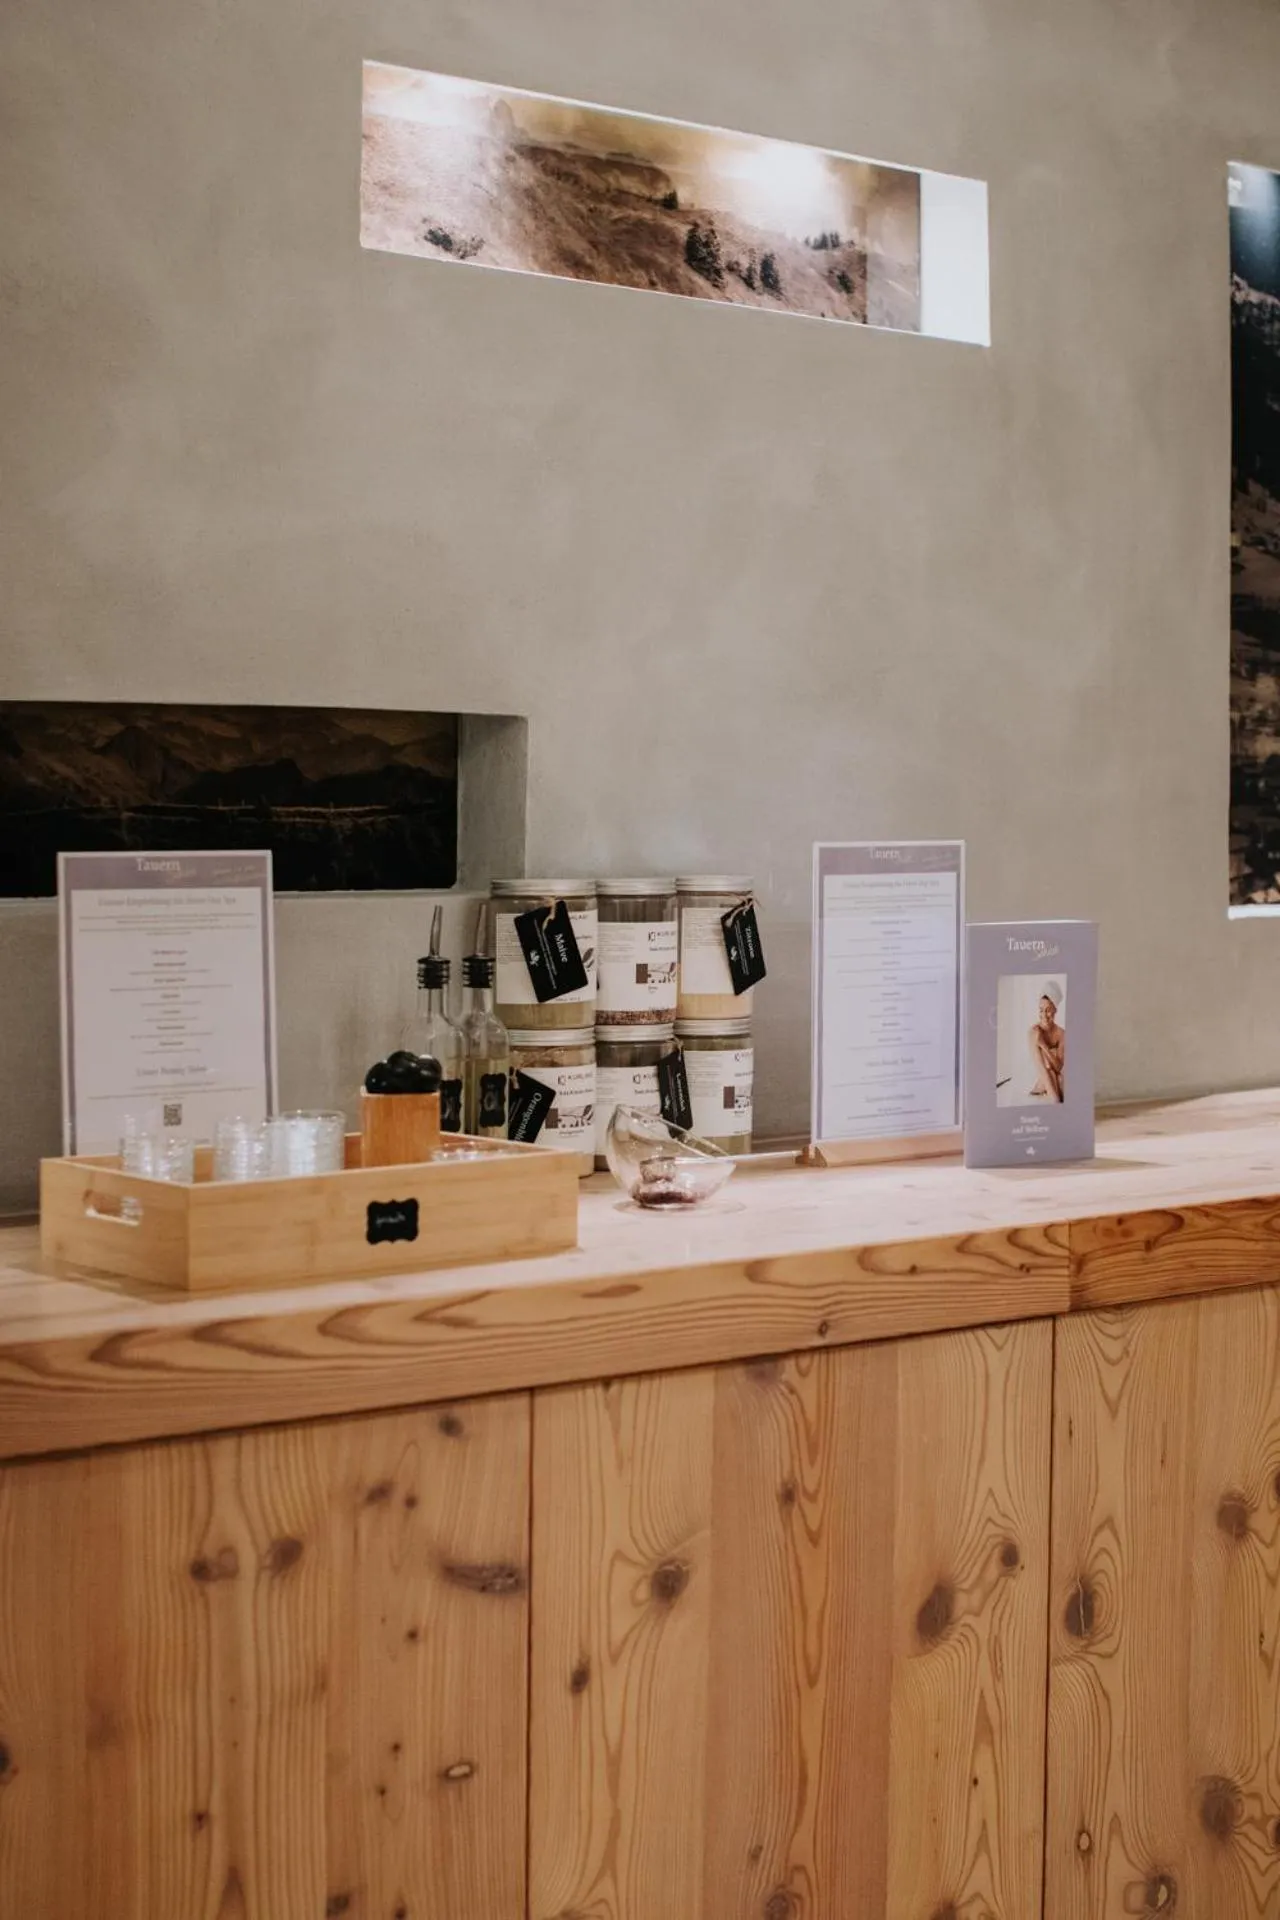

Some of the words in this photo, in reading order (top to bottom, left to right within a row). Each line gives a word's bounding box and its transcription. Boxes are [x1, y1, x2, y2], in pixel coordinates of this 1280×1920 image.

[136, 857, 182, 872] Tauern
[554, 933, 569, 964] Malve
[1006, 936, 1046, 952] Tauern
